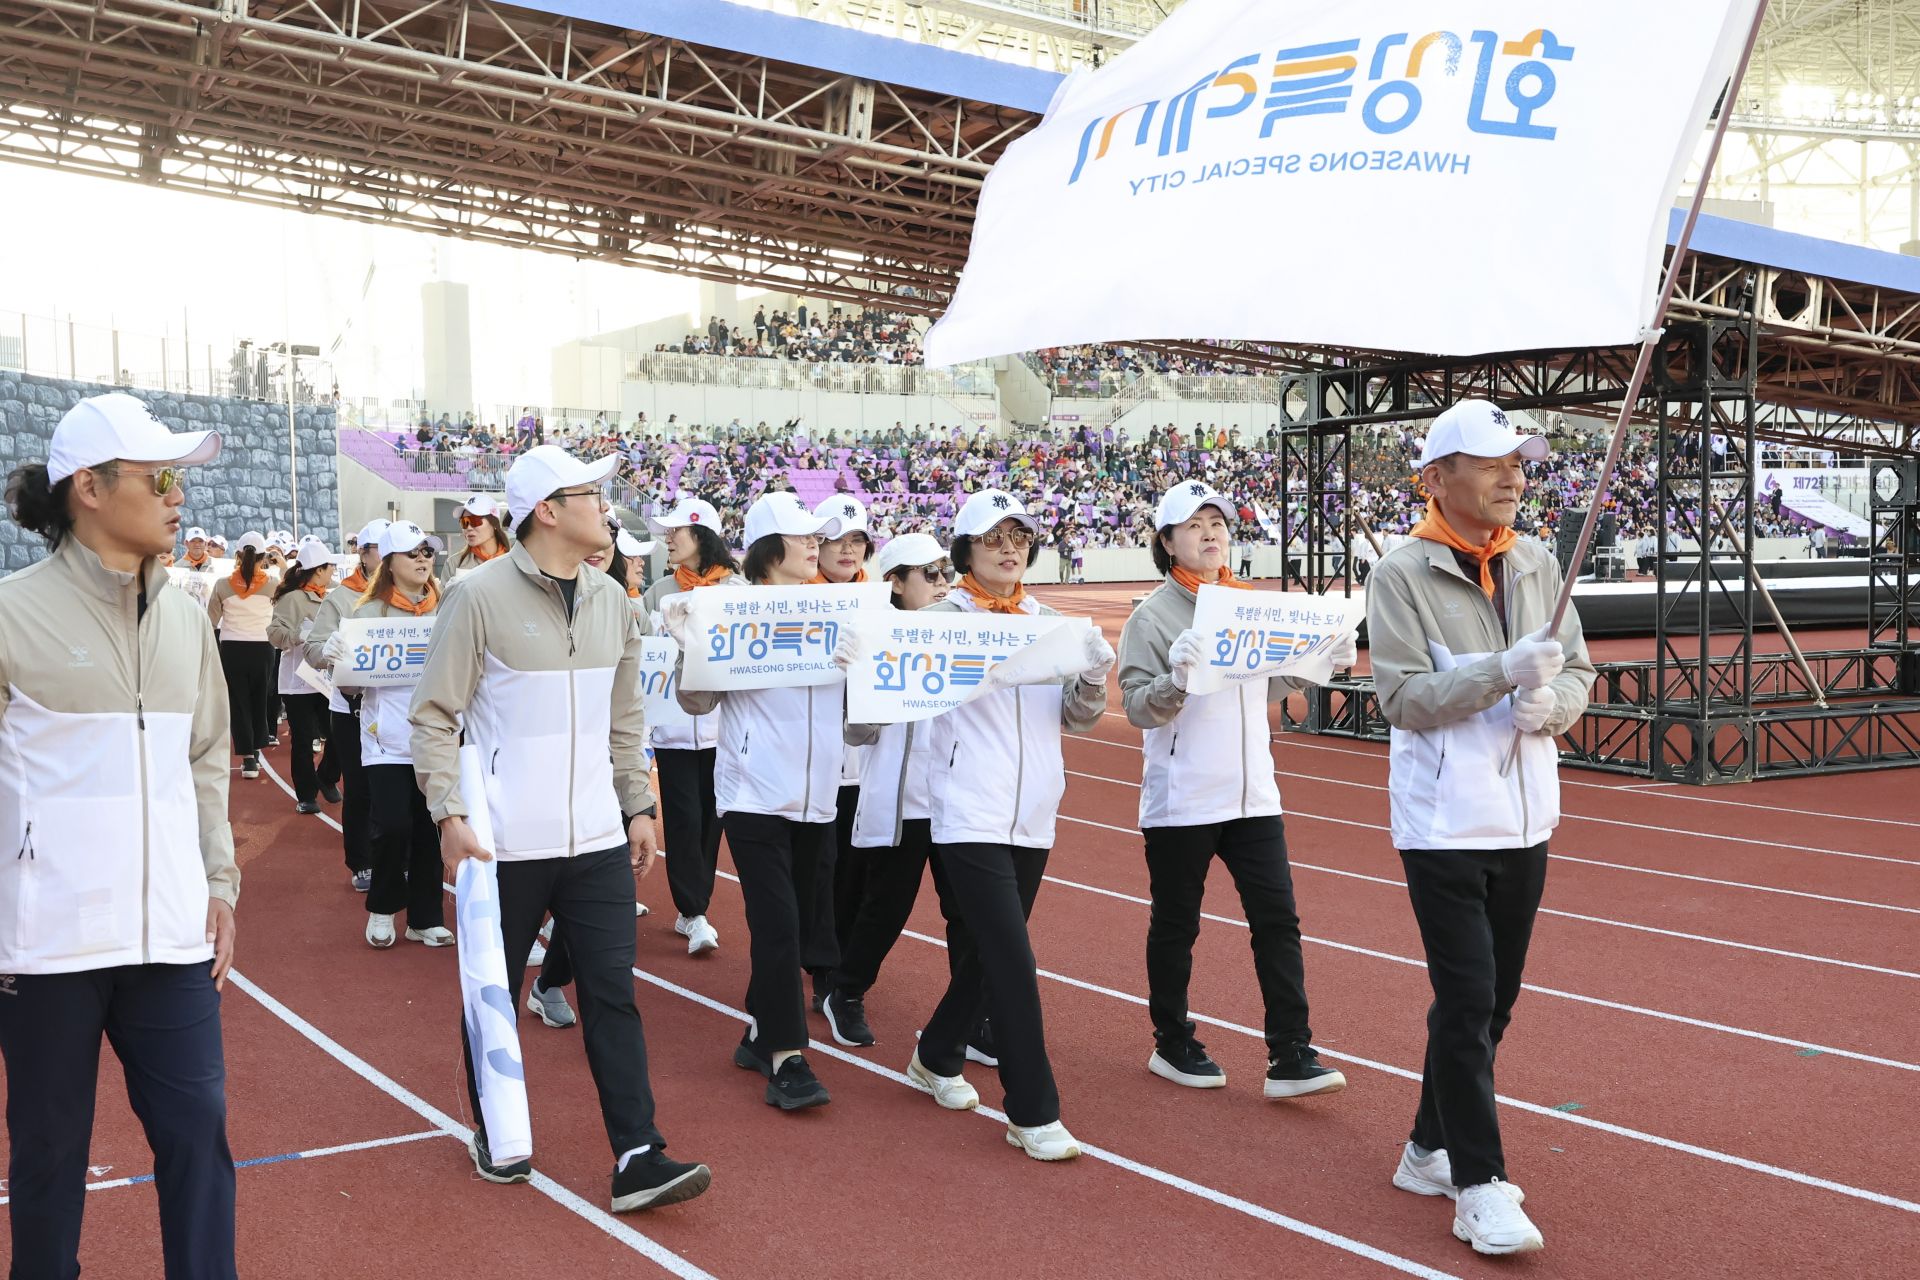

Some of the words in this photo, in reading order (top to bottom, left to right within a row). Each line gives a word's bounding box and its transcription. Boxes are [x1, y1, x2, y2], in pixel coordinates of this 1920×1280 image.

[723, 601, 760, 616] 특별한
[764, 600, 793, 615] 시민,
[797, 599, 832, 614] 빛나는
[835, 598, 859, 611] 도시
[1234, 606, 1262, 621] 특별한
[1263, 607, 1285, 623] 시민,
[1289, 610, 1322, 626] 빛나는
[1323, 613, 1345, 628] 도시
[366, 627, 395, 639] 특별한
[398, 627, 420, 638] 시민,
[890, 628, 935, 645] 특별한
[938, 630, 972, 647] 시민,
[977, 631, 1020, 647] 빛나는
[1024, 634, 1038, 646] 도
[707, 621, 839, 662] 화성특례
[644, 650, 668, 664] 도시
[369, 672, 411, 680] HWASEONG
[729, 663, 784, 675] HWASEONG
[786, 661, 825, 672] SPECIAL
